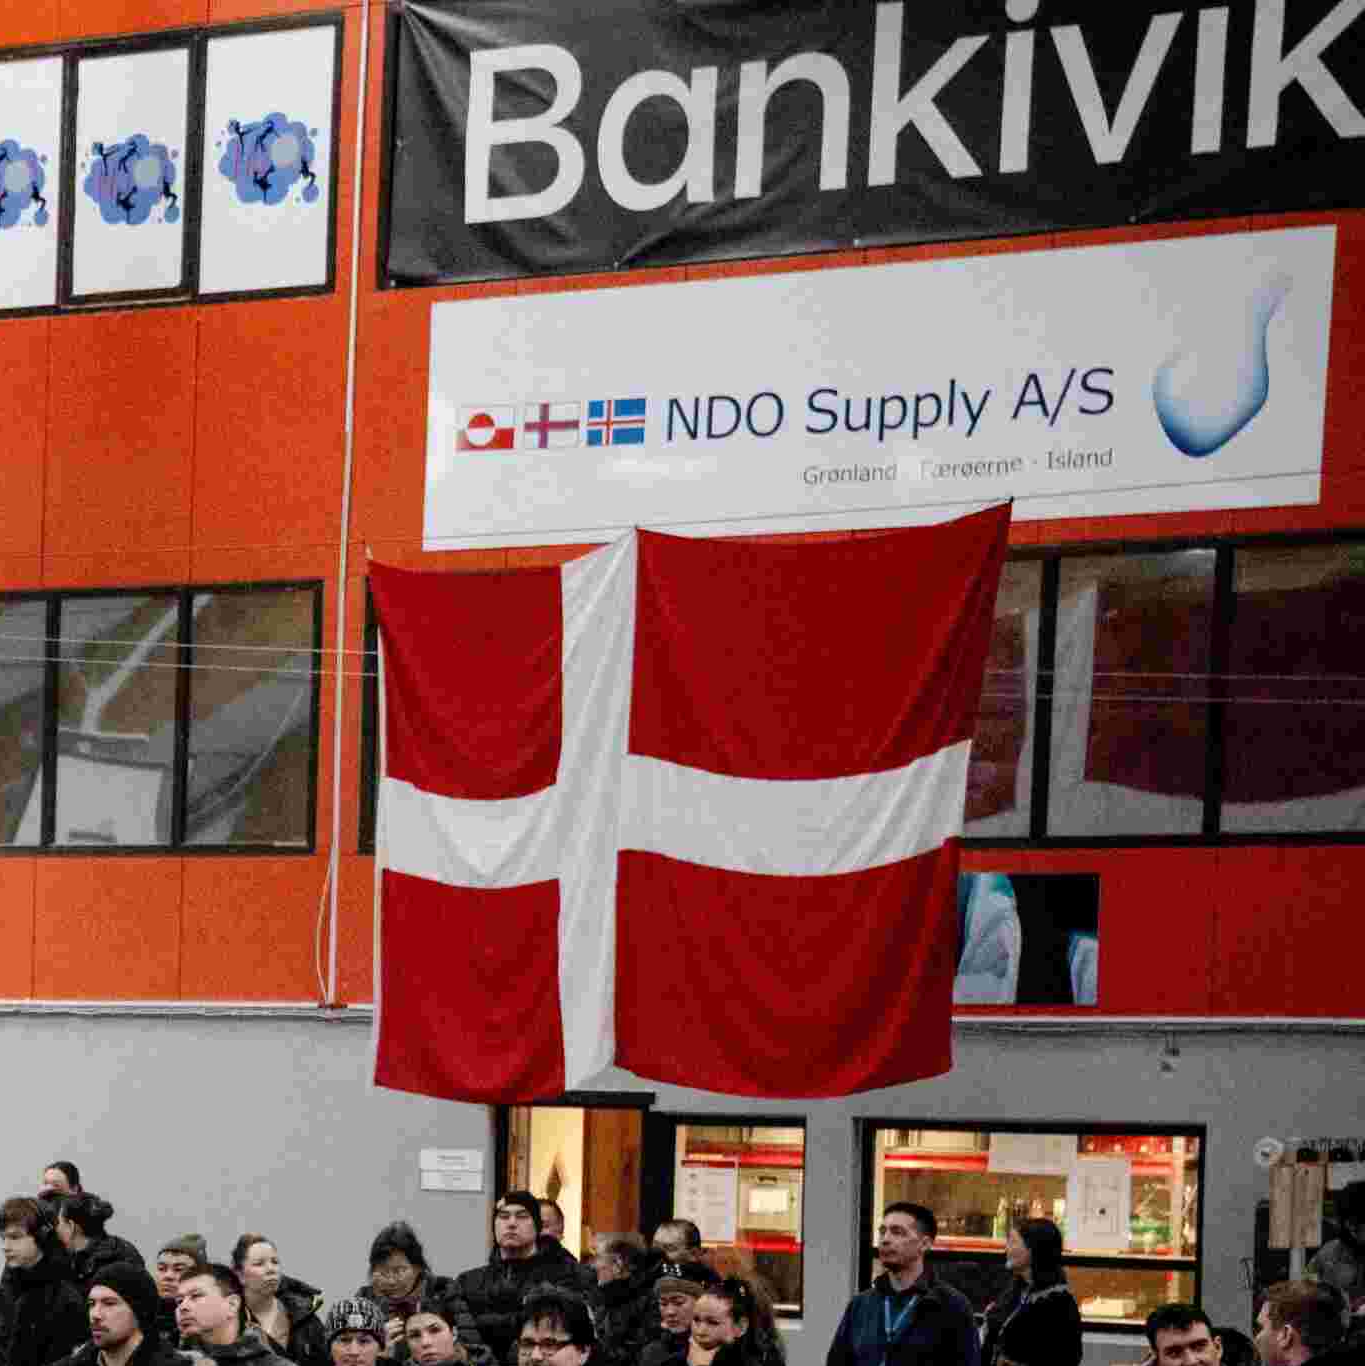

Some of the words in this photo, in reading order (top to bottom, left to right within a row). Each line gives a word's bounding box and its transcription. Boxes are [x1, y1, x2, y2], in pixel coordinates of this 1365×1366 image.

[464, 0, 1365, 224] Bankivik
[666, 390, 784, 442] NDO
[805, 378, 992, 442] Supply
[1011, 367, 1115, 427] A/S
[1045, 446, 1115, 471] Island
